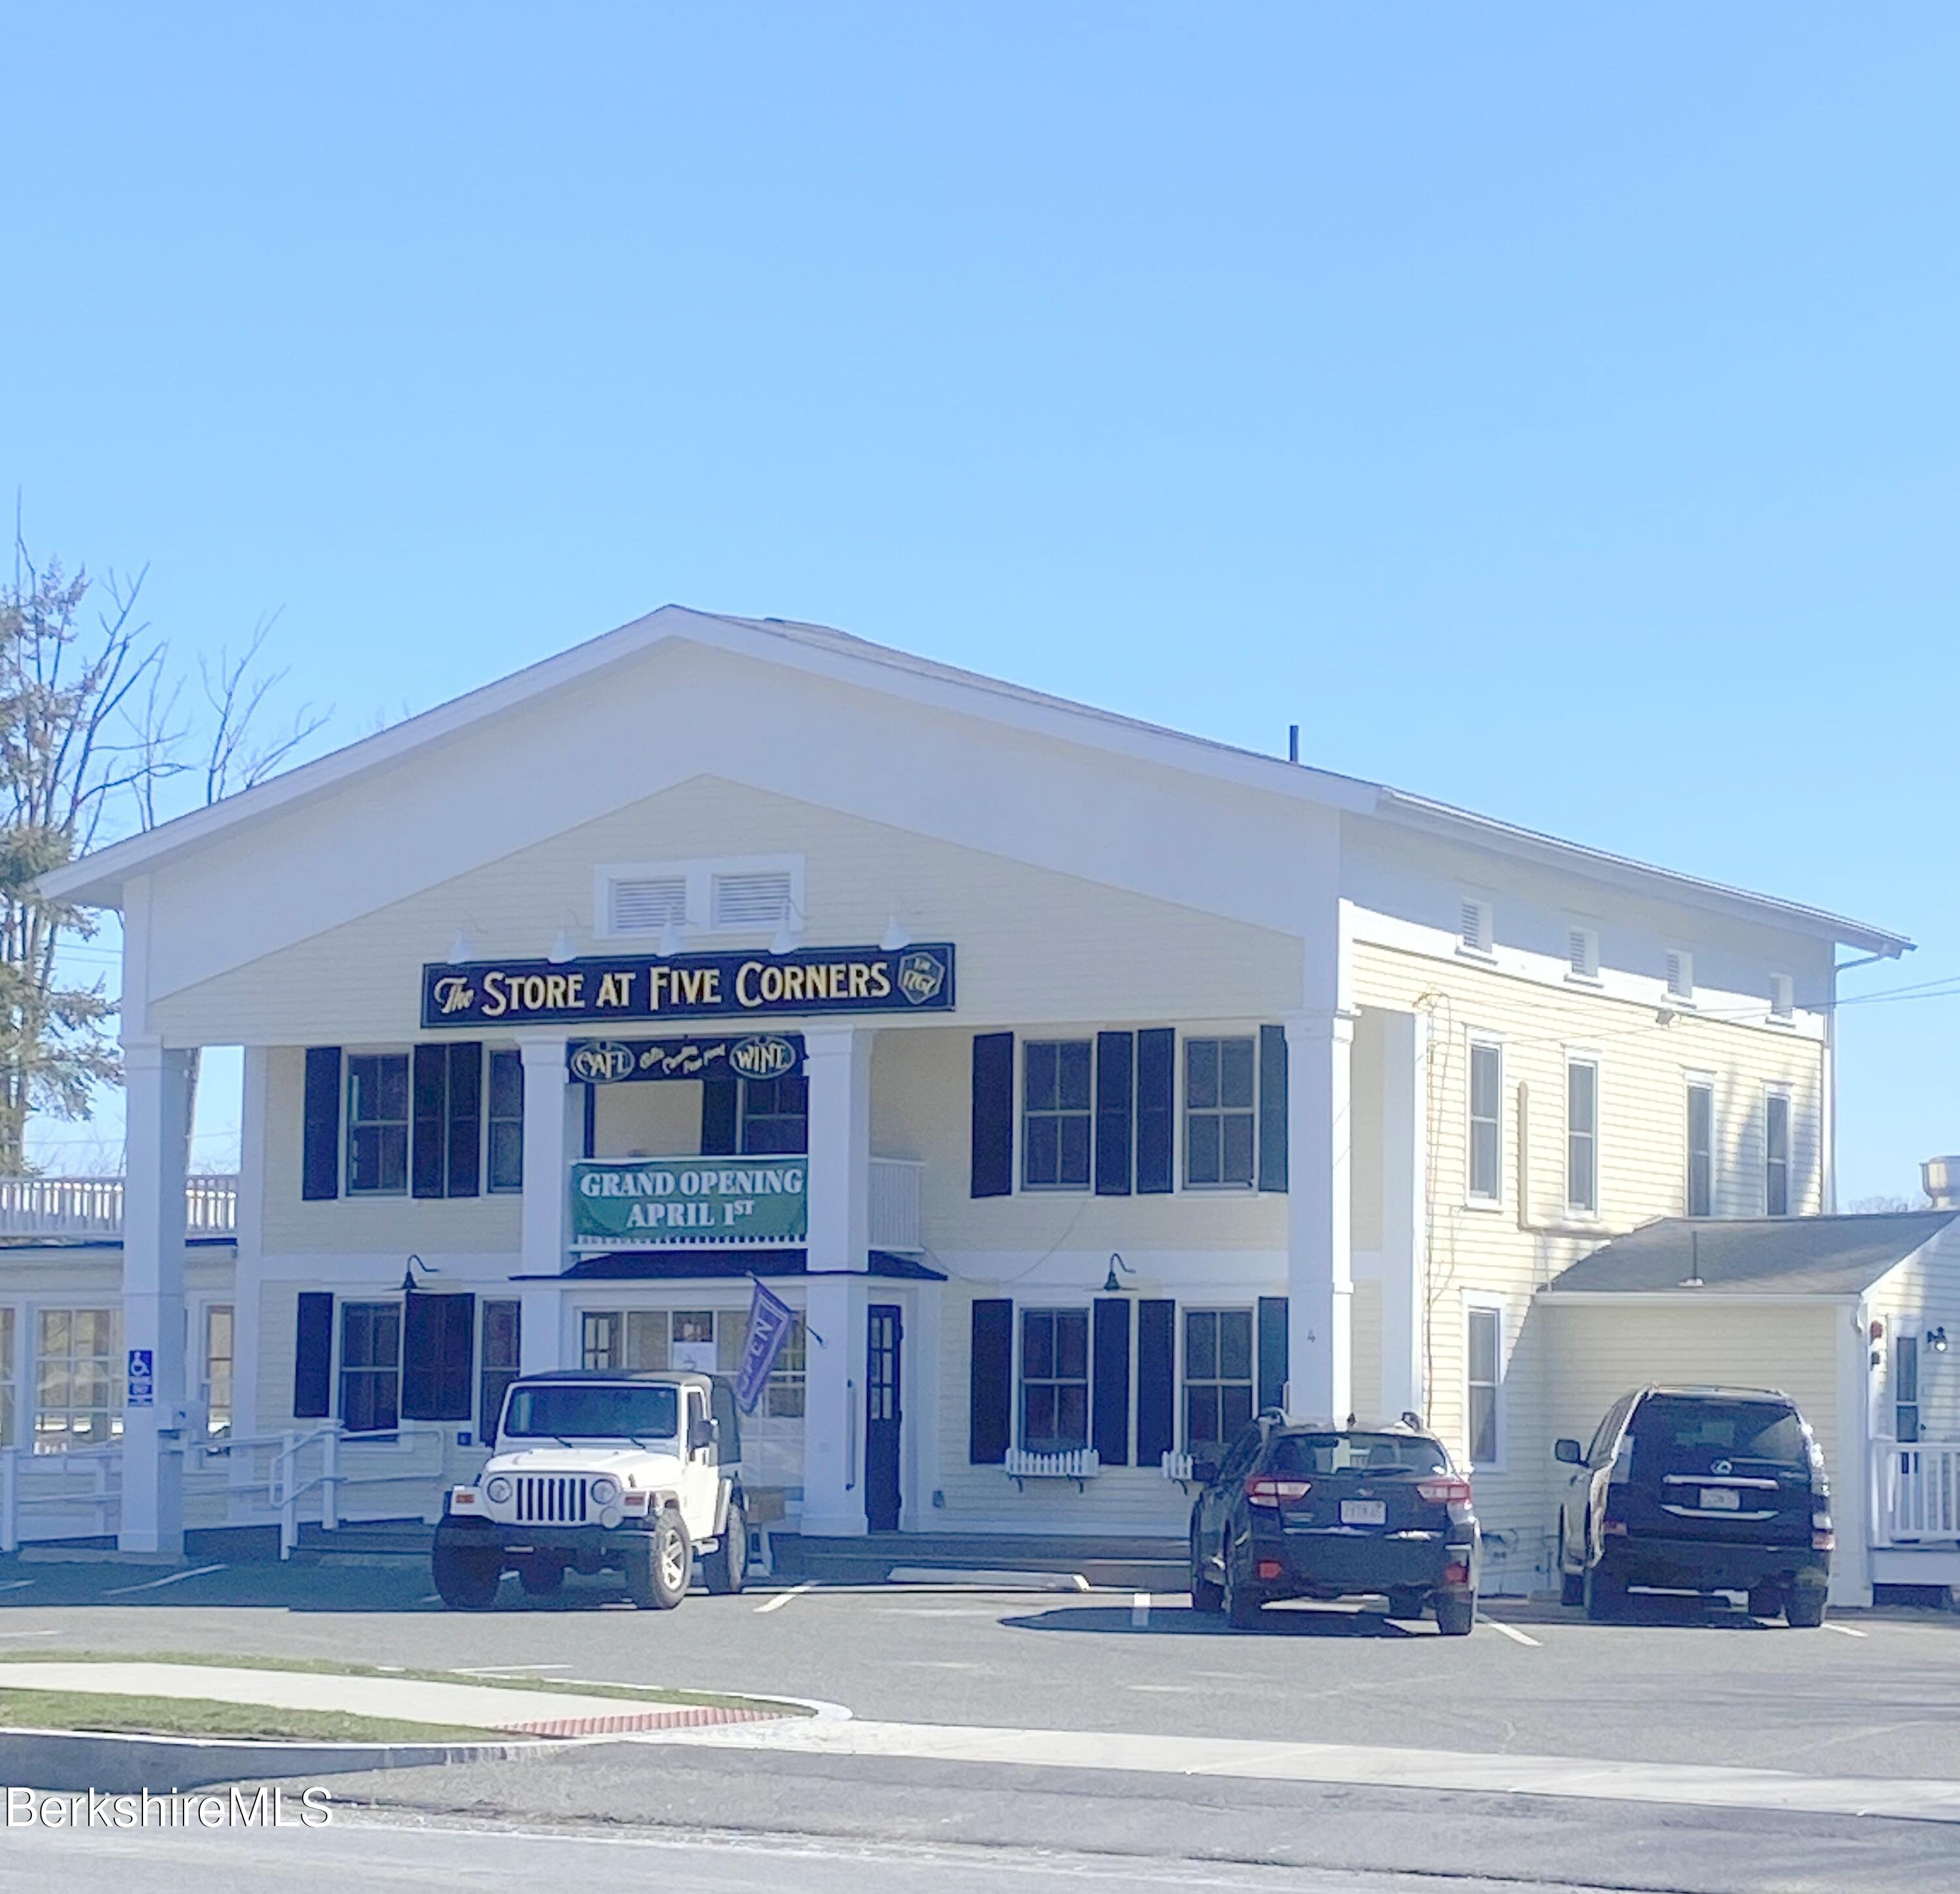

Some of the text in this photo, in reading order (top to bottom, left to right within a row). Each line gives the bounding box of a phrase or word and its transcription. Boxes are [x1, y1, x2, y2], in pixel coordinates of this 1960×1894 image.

[434, 960, 891, 1017] The STORE AT FIVE CORNERS
[736, 1042, 789, 1073] WINE
[580, 1168, 804, 1198] GRAND OPENING
[626, 1202, 715, 1228] APRIL
